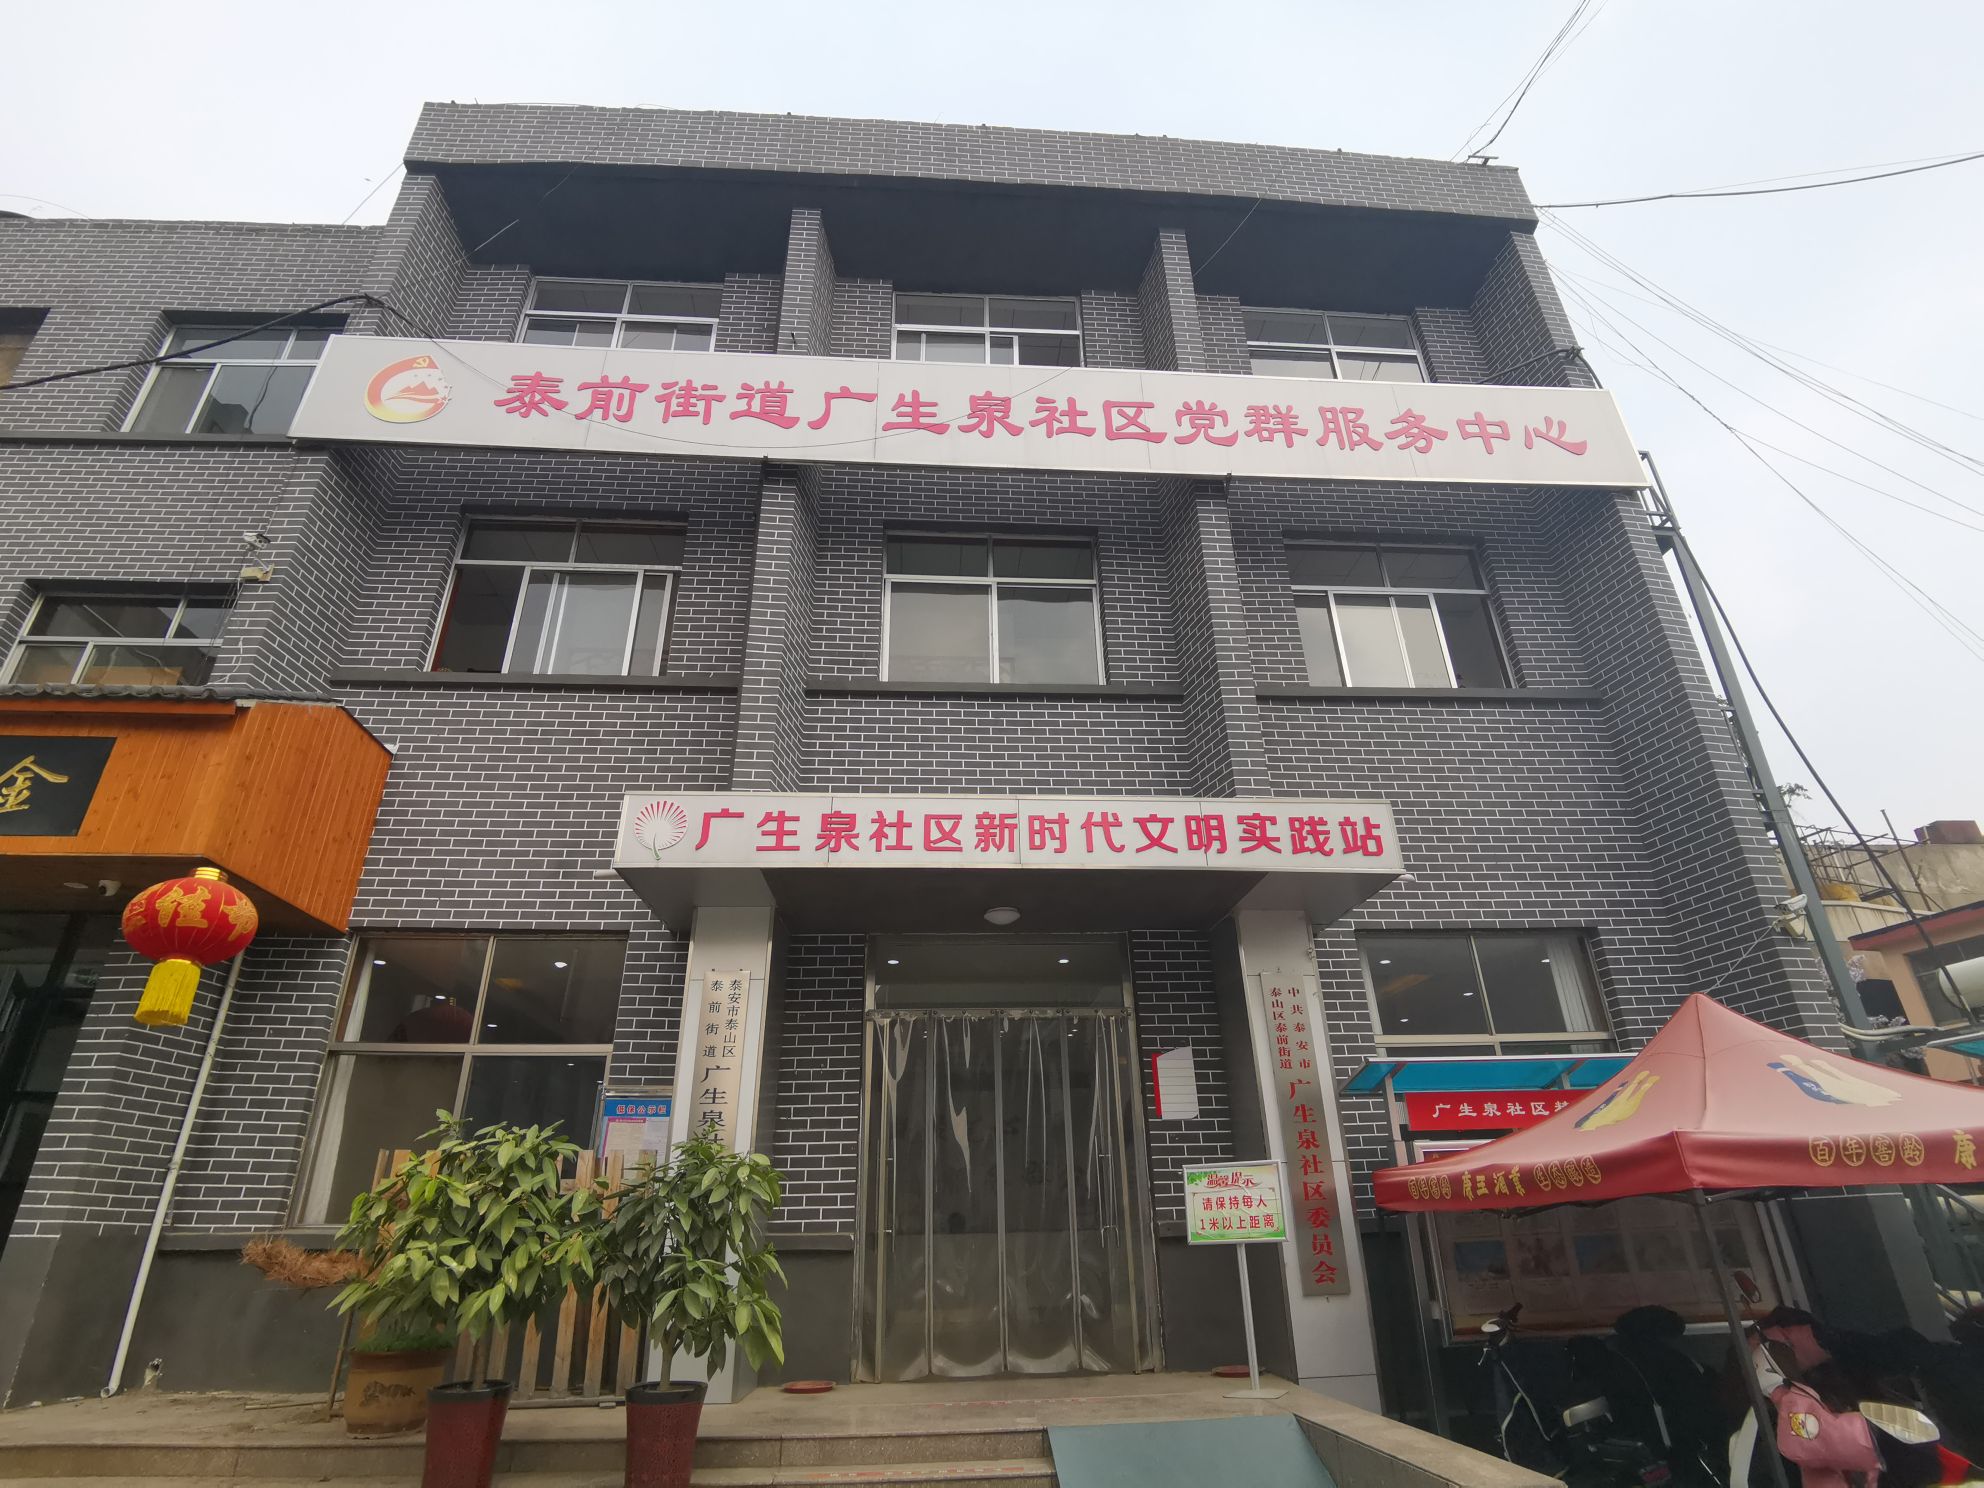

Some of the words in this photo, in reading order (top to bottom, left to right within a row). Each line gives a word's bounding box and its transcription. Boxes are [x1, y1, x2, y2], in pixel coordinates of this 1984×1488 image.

[494, 371, 1588, 456] 泰前街道广生泉社区党群服务中心
[694, 809, 1384, 857] 广生泉社区新时代文明实践站
[702, 980, 724, 1058] 泰前街道
[721, 979, 742, 1058] 泰安市泰山区
[1271, 987, 1293, 1070] 泰山区泰前街道
[1288, 987, 1311, 1069] 中共泰安市
[1202, 1195, 1268, 1211] 请保持每人
[1289, 1079, 1337, 1284] 广生泉社区委员会
[1200, 1214, 1275, 1231] 1米以上距离
